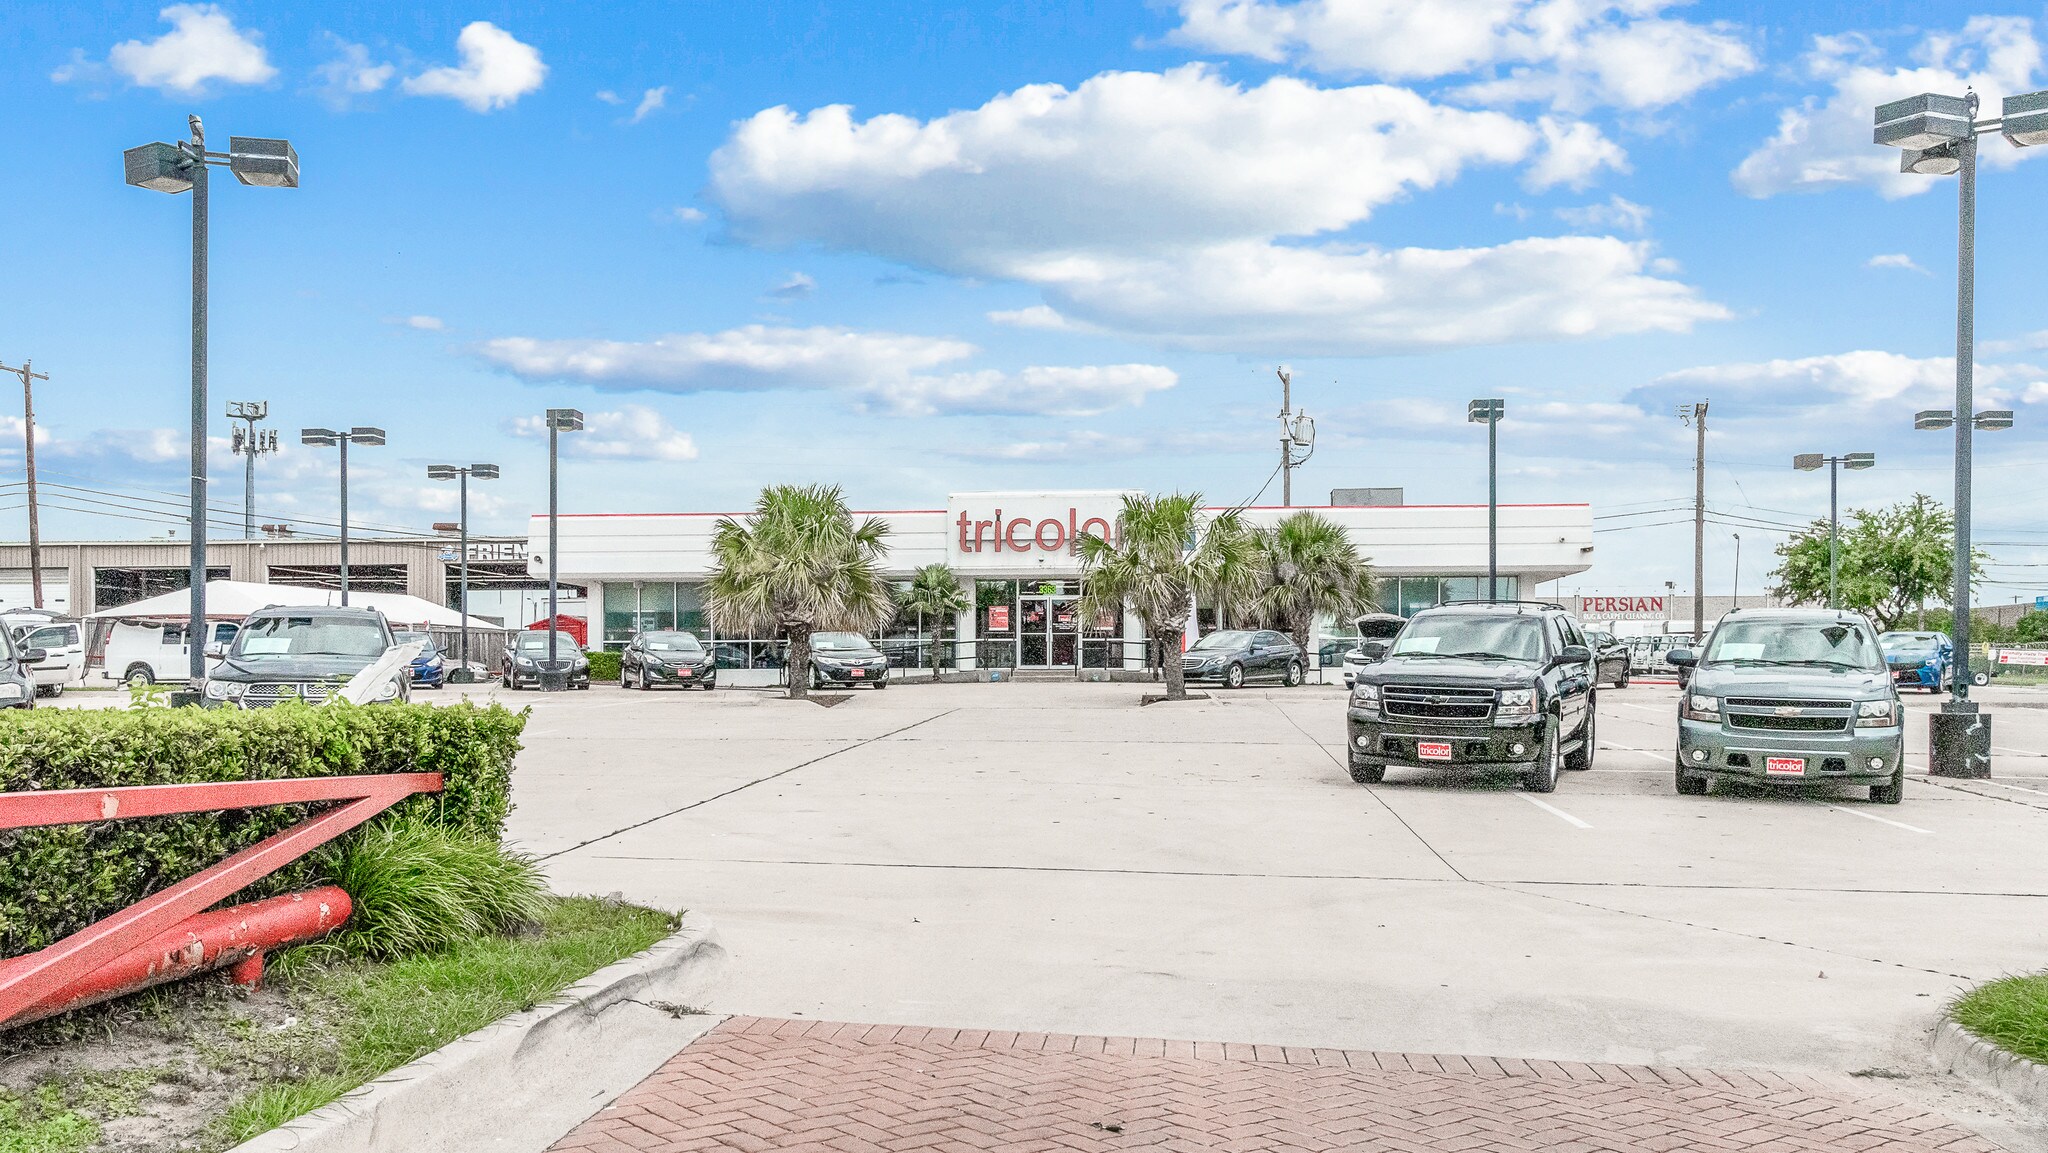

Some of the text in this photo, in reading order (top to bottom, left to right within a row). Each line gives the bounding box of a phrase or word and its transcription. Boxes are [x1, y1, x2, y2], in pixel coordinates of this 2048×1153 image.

[1582, 597, 1663, 611] PERSIAN
[1421, 746, 1449, 755] tricolor
[1769, 761, 1802, 771] tricolor
